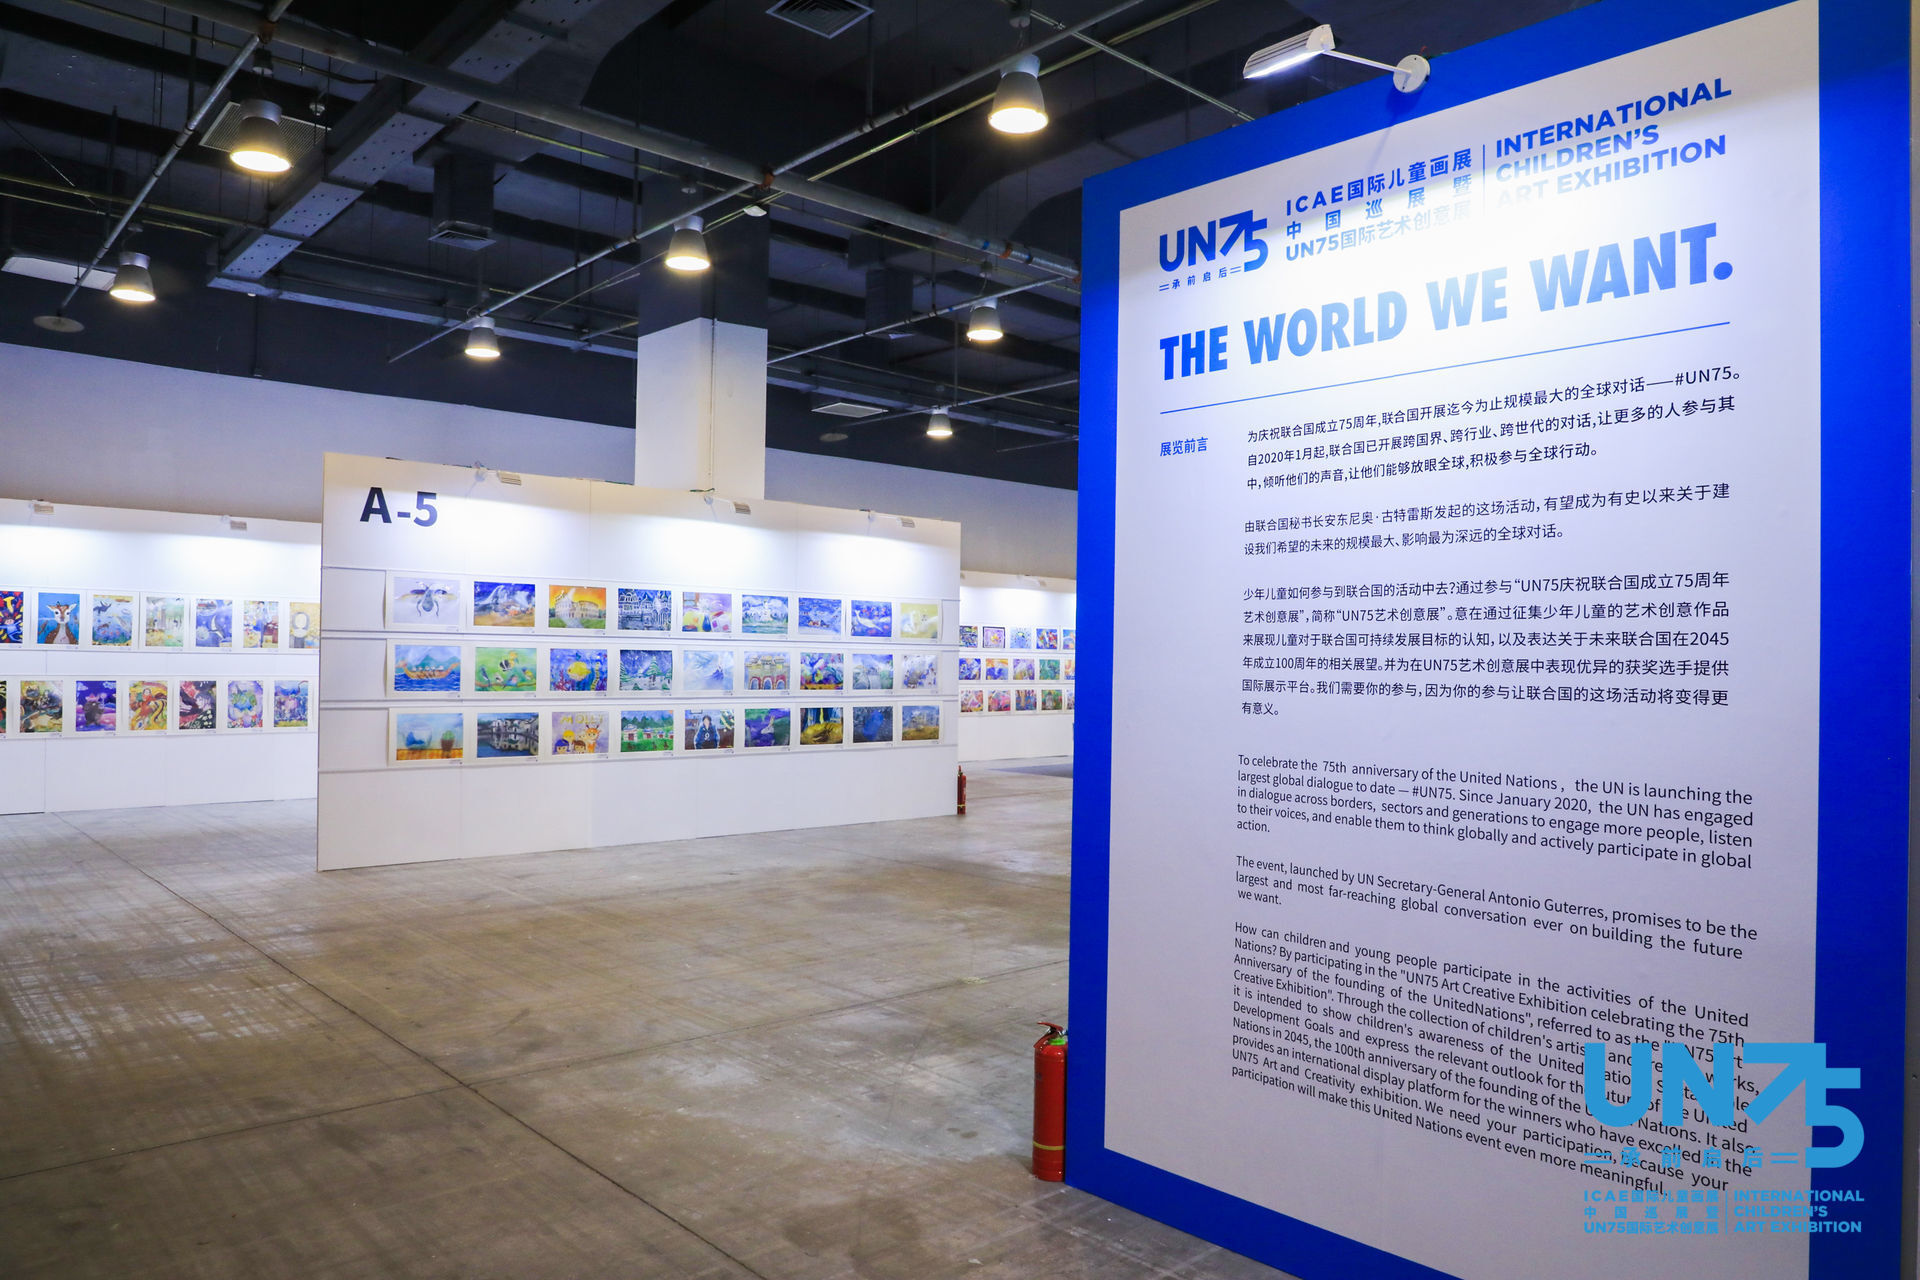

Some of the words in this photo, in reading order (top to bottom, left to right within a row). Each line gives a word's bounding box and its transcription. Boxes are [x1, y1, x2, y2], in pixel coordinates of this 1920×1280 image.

[1496, 78, 1732, 158] INTERNATIONAL
[1496, 124, 1659, 182] CHILDREN’S
[1496, 179, 1549, 209] ART
[1556, 134, 1726, 194] EXHIBITION
[1159, 325, 1228, 380] THE
[1244, 289, 1407, 365] WORLD
[1425, 266, 1508, 331] WE
[1529, 222, 1733, 312] WANT.
[1160, 437, 1208, 457] 展览前言
[360, 486, 437, 527] A-5
[1241, 701, 1279, 716] 有意义。
[1237, 754, 1250, 766] To
[1251, 755, 1298, 770] celebrate
[1300, 758, 1318, 771] the
[1322, 760, 1346, 773] 75th
[1351, 763, 1419, 782] anniversary
[1420, 767, 1434, 780] of
[1436, 768, 1456, 782] the
[1459, 770, 1502, 786] United
[1505, 773, 1564, 793] Nations,
[1574, 778, 1598, 793] the
[1602, 780, 1624, 795] UN
[1628, 782, 1640, 796] is
[1644, 782, 1722, 806] launching
[1725, 788, 1752, 805] the
[1237, 769, 1270, 785] largest
[1272, 772, 1304, 788] global
[1306, 775, 1354, 793] dialogue
[1355, 780, 1367, 793] to
[1369, 780, 1396, 795] date
[1412, 785, 1455, 800] #UN75.
[1458, 788, 1494, 804] Since
[1496, 792, 1551, 812] January
[1554, 796, 1592, 814] 2020,
[1598, 799, 1623, 815] the
[1626, 802, 1648, 817] UN
[1653, 803, 1680, 820] has
[1684, 810, 1753, 828] engaged
[1236, 819, 1270, 833] action.
[1236, 802, 1247, 814] to
[1249, 803, 1273, 816] their
[1274, 806, 1310, 822] voices,
[1311, 811, 1332, 823] and
[1334, 813, 1372, 828] enable
[1374, 816, 1405, 831] them
[1407, 820, 1420, 833] to
[1422, 821, 1454, 837] think
[1457, 825, 1508, 846] globally
[1511, 832, 1536, 846] and
[1540, 835, 1594, 855] actively
[1597, 842, 1678, 861] participate
[1682, 847, 1696, 863] in
[1701, 850, 1752, 869] global
[1237, 785, 1247, 797] in
[1248, 786, 1292, 804] dialogue
[1294, 794, 1328, 806] across
[1330, 794, 1376, 813] borders,
[1381, 802, 1423, 816] sectors
[1425, 805, 1449, 818] and
[1452, 809, 1528, 826] generations
[1530, 814, 1545, 827] to
[1548, 818, 1600, 836] engage
[1603, 823, 1642, 837] more
[1646, 826, 1704, 845] people,
[1709, 828, 1752, 848] listen
[1235, 870, 1269, 887] largest
[1272, 878, 1292, 890] and
[1297, 883, 1324, 895] most
[1328, 884, 1396, 910] far-reaching
[1400, 896, 1438, 913] global
[1443, 905, 1526, 926] conversation
[1533, 918, 1564, 932] ever
[1569, 924, 1588, 936] on
[1592, 923, 1653, 950] building
[1659, 934, 1686, 951] the
[1692, 938, 1742, 959] future
[1236, 855, 1255, 868] The
[1256, 860, 1287, 875] event,
[1289, 862, 1338, 880] launched
[1341, 869, 1355, 886] by
[1357, 872, 1374, 886] UN
[1377, 875, 1485, 902] Secretary-General
[1488, 890, 1541, 910] Antonio
[1544, 898, 1608, 922] Guterres,
[1612, 910, 1682, 930] promises
[1685, 917, 1701, 932] to
[1706, 919, 1726, 936] be
[1729, 923, 1757, 940] the
[1237, 889, 1252, 900] we
[1253, 892, 1282, 905] want.
[1234, 937, 1277, 956] Nations?
[1279, 946, 1292, 961] By
[1294, 951, 1363, 976] participating
[1364, 962, 1375, 976] in
[1377, 965, 1397, 980] the
[1400, 969, 1439, 988] "UN75
[1440, 977, 1460, 993] Art
[1462, 981, 1515, 1003] Creative
[1518, 992, 1587, 1017] Exhibition
[1590, 1008, 1675, 1038] celebrating
[1678, 1022, 1704, 1040] the
[1708, 1028, 1744, 1046] 75th
[1235, 921, 1257, 935] How
[1261, 928, 1279, 940] can
[1283, 930, 1326, 949] children
[1328, 941, 1350, 953] and
[1354, 946, 1391, 964] young
[1396, 953, 1437, 970] people
[1443, 962, 1512, 984] participate
[1518, 972, 1530, 987] in
[1537, 976, 1560, 993] the
[1566, 984, 1631, 1006] activities
[1638, 995, 1654, 1010] of
[1660, 998, 1687, 1016] the
[1694, 1004, 1748, 1027] United
[1231, 1066, 1295, 1091] participation
[1297, 1084, 1316, 1098] will
[1318, 1090, 1348, 1106] make
[1349, 1097, 1371, 1113] this
[1373, 1103, 1412, 1125] United
[1415, 1114, 1463, 1139] Nations
[1465, 1131, 1501, 1150] event
[1504, 1142, 1536, 1159] even
[1540, 1152, 1576, 1170] more
